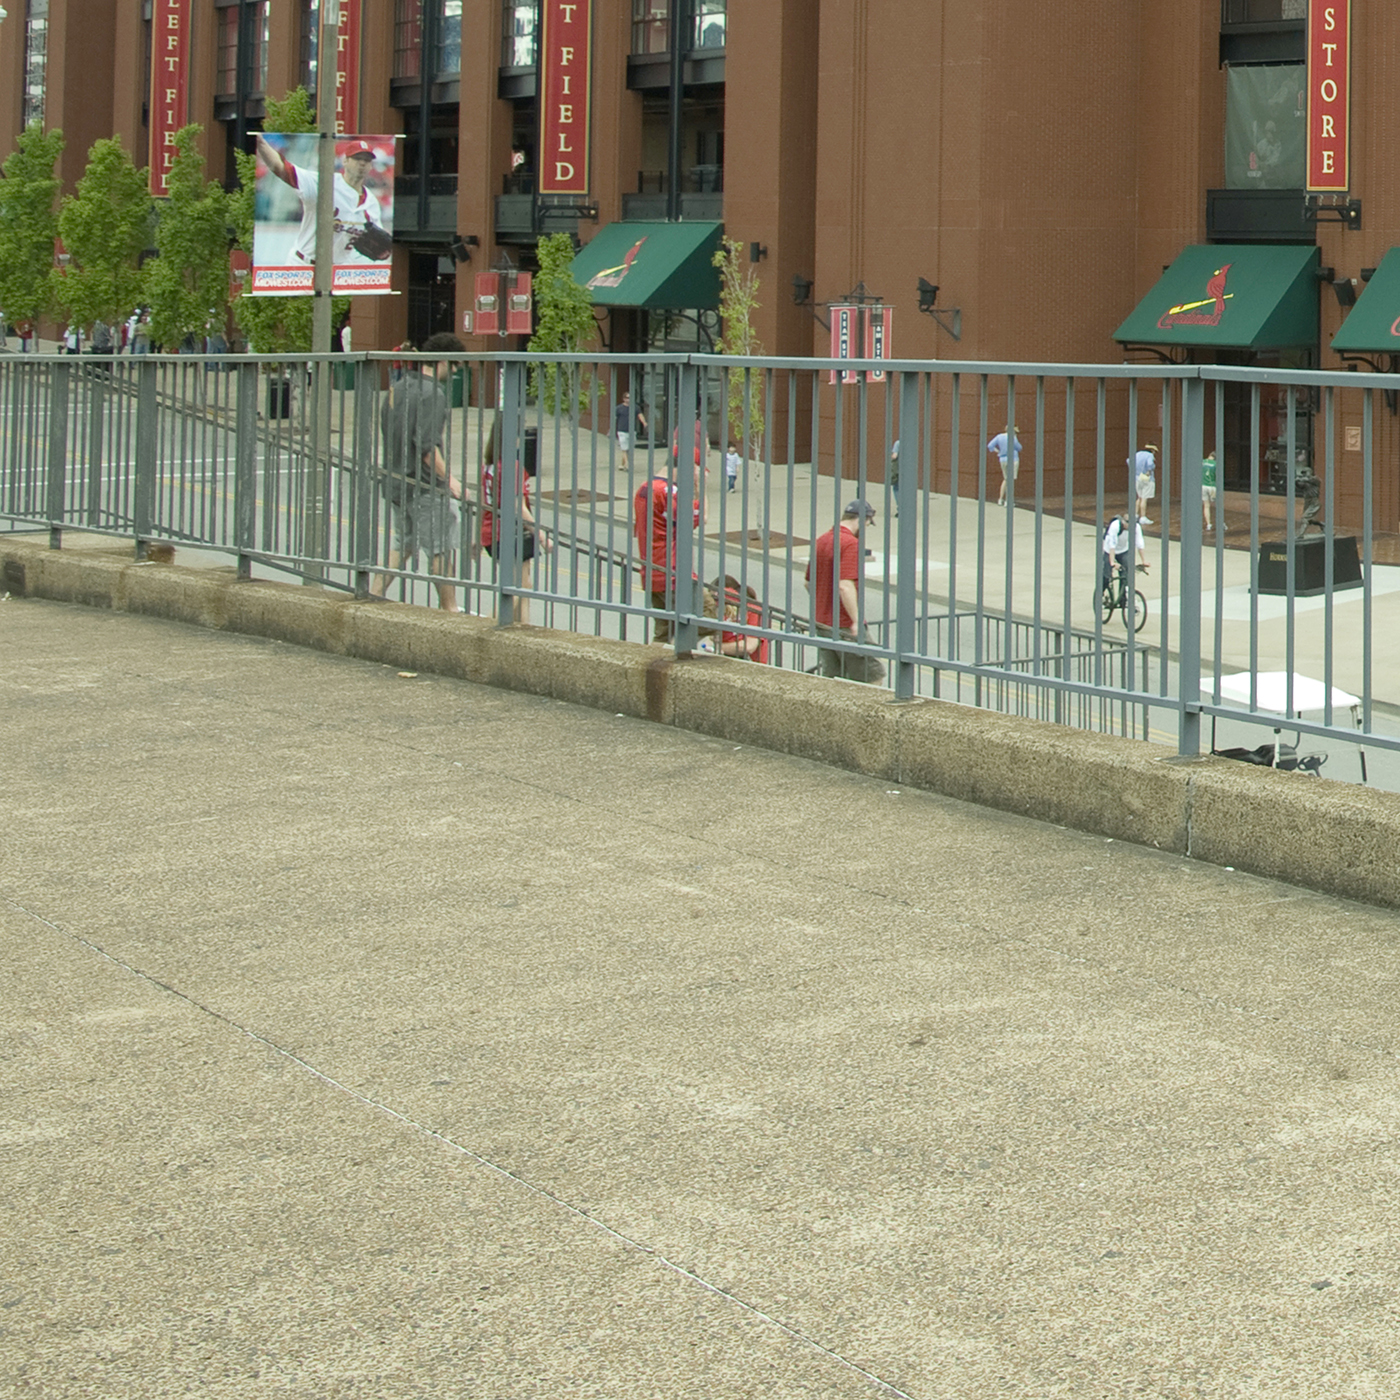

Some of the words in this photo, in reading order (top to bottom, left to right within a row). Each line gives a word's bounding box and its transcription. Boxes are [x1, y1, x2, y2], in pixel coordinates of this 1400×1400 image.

[335, 71, 346, 135] FIE
[554, 47, 574, 181] FIELD
[1321, 8, 1337, 174] STORE
